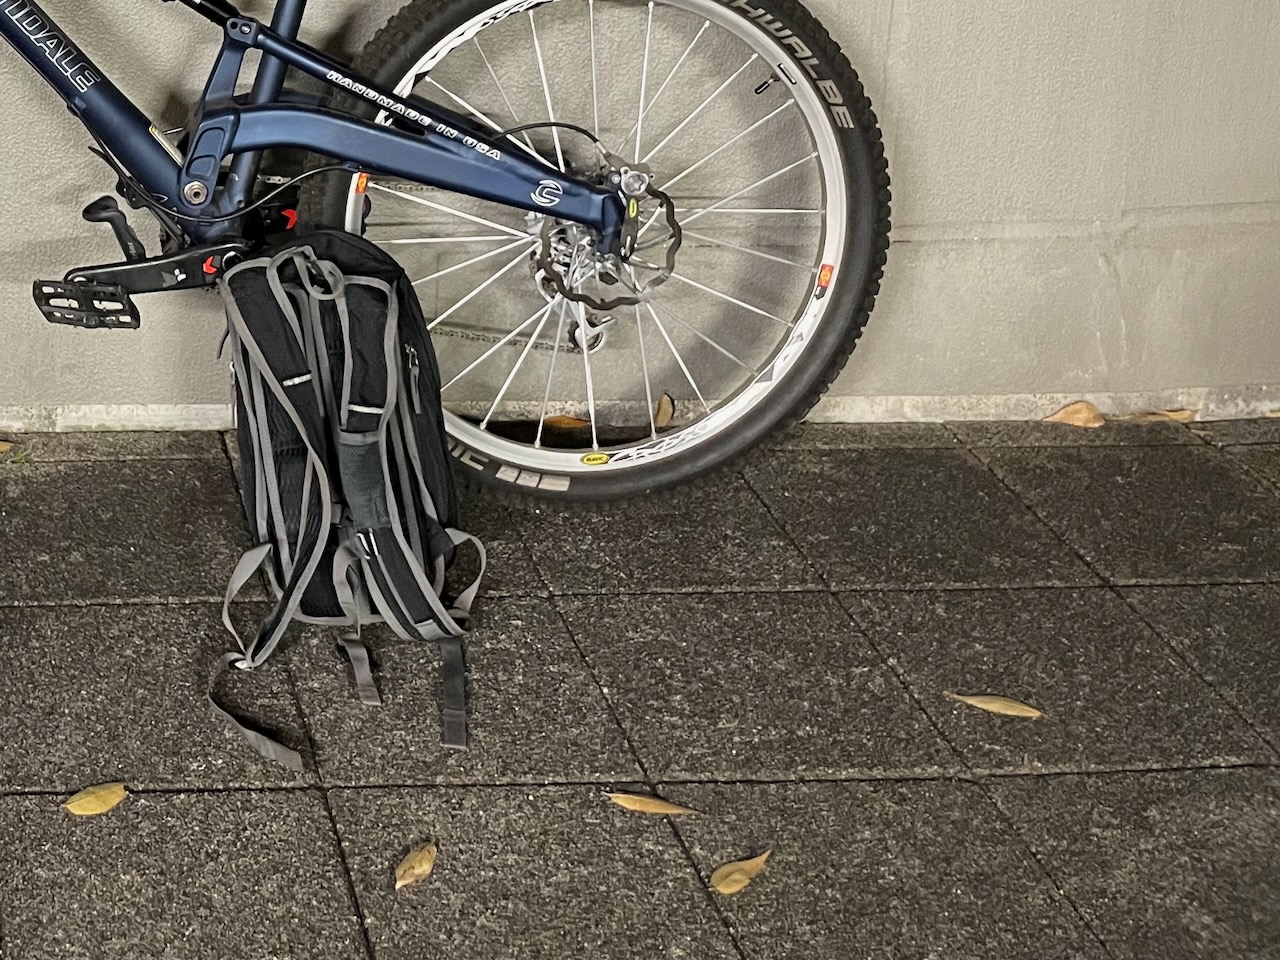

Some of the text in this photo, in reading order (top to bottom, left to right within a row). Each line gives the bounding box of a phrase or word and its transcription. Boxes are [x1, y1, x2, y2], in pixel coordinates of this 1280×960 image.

[326, 69, 502, 161] HANDMADE IN USA
